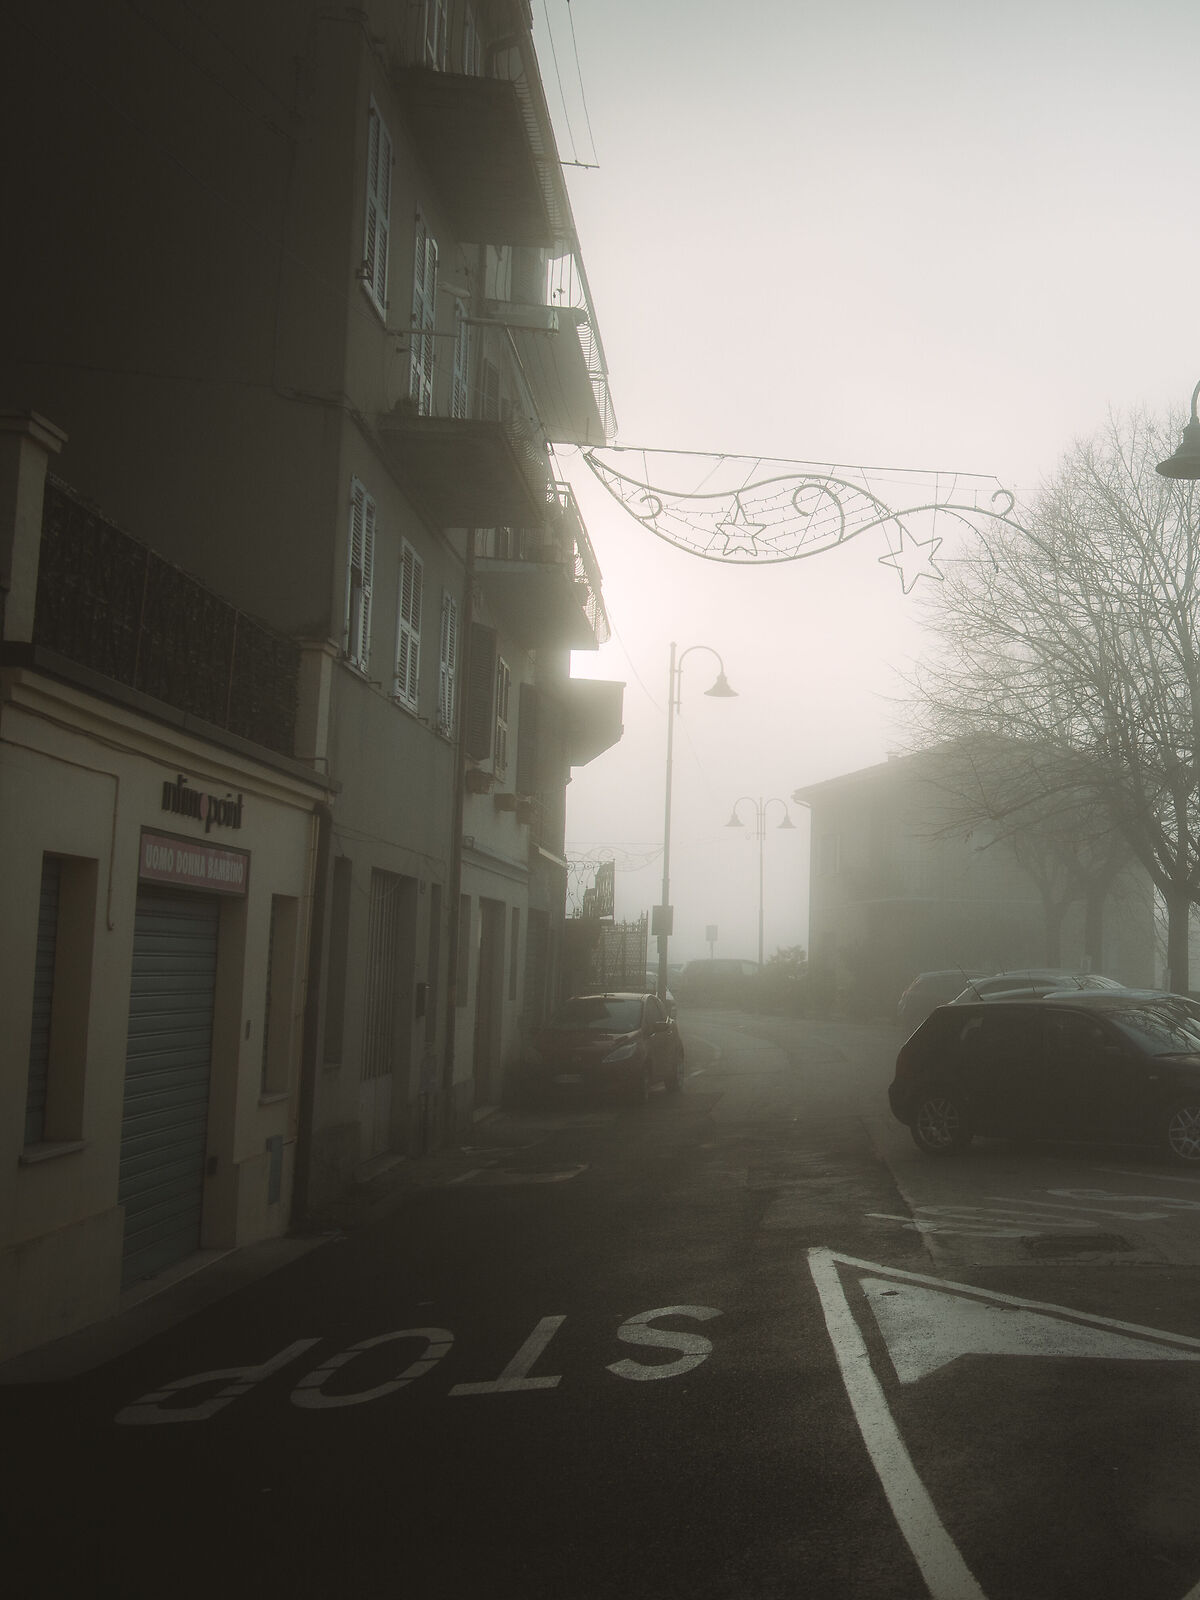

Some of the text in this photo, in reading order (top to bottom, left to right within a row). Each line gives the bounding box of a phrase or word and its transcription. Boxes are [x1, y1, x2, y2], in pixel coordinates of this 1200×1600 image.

[145, 844, 243, 884] UOMO DONNA BAMBINO
[114, 1304, 724, 1426] STOP
